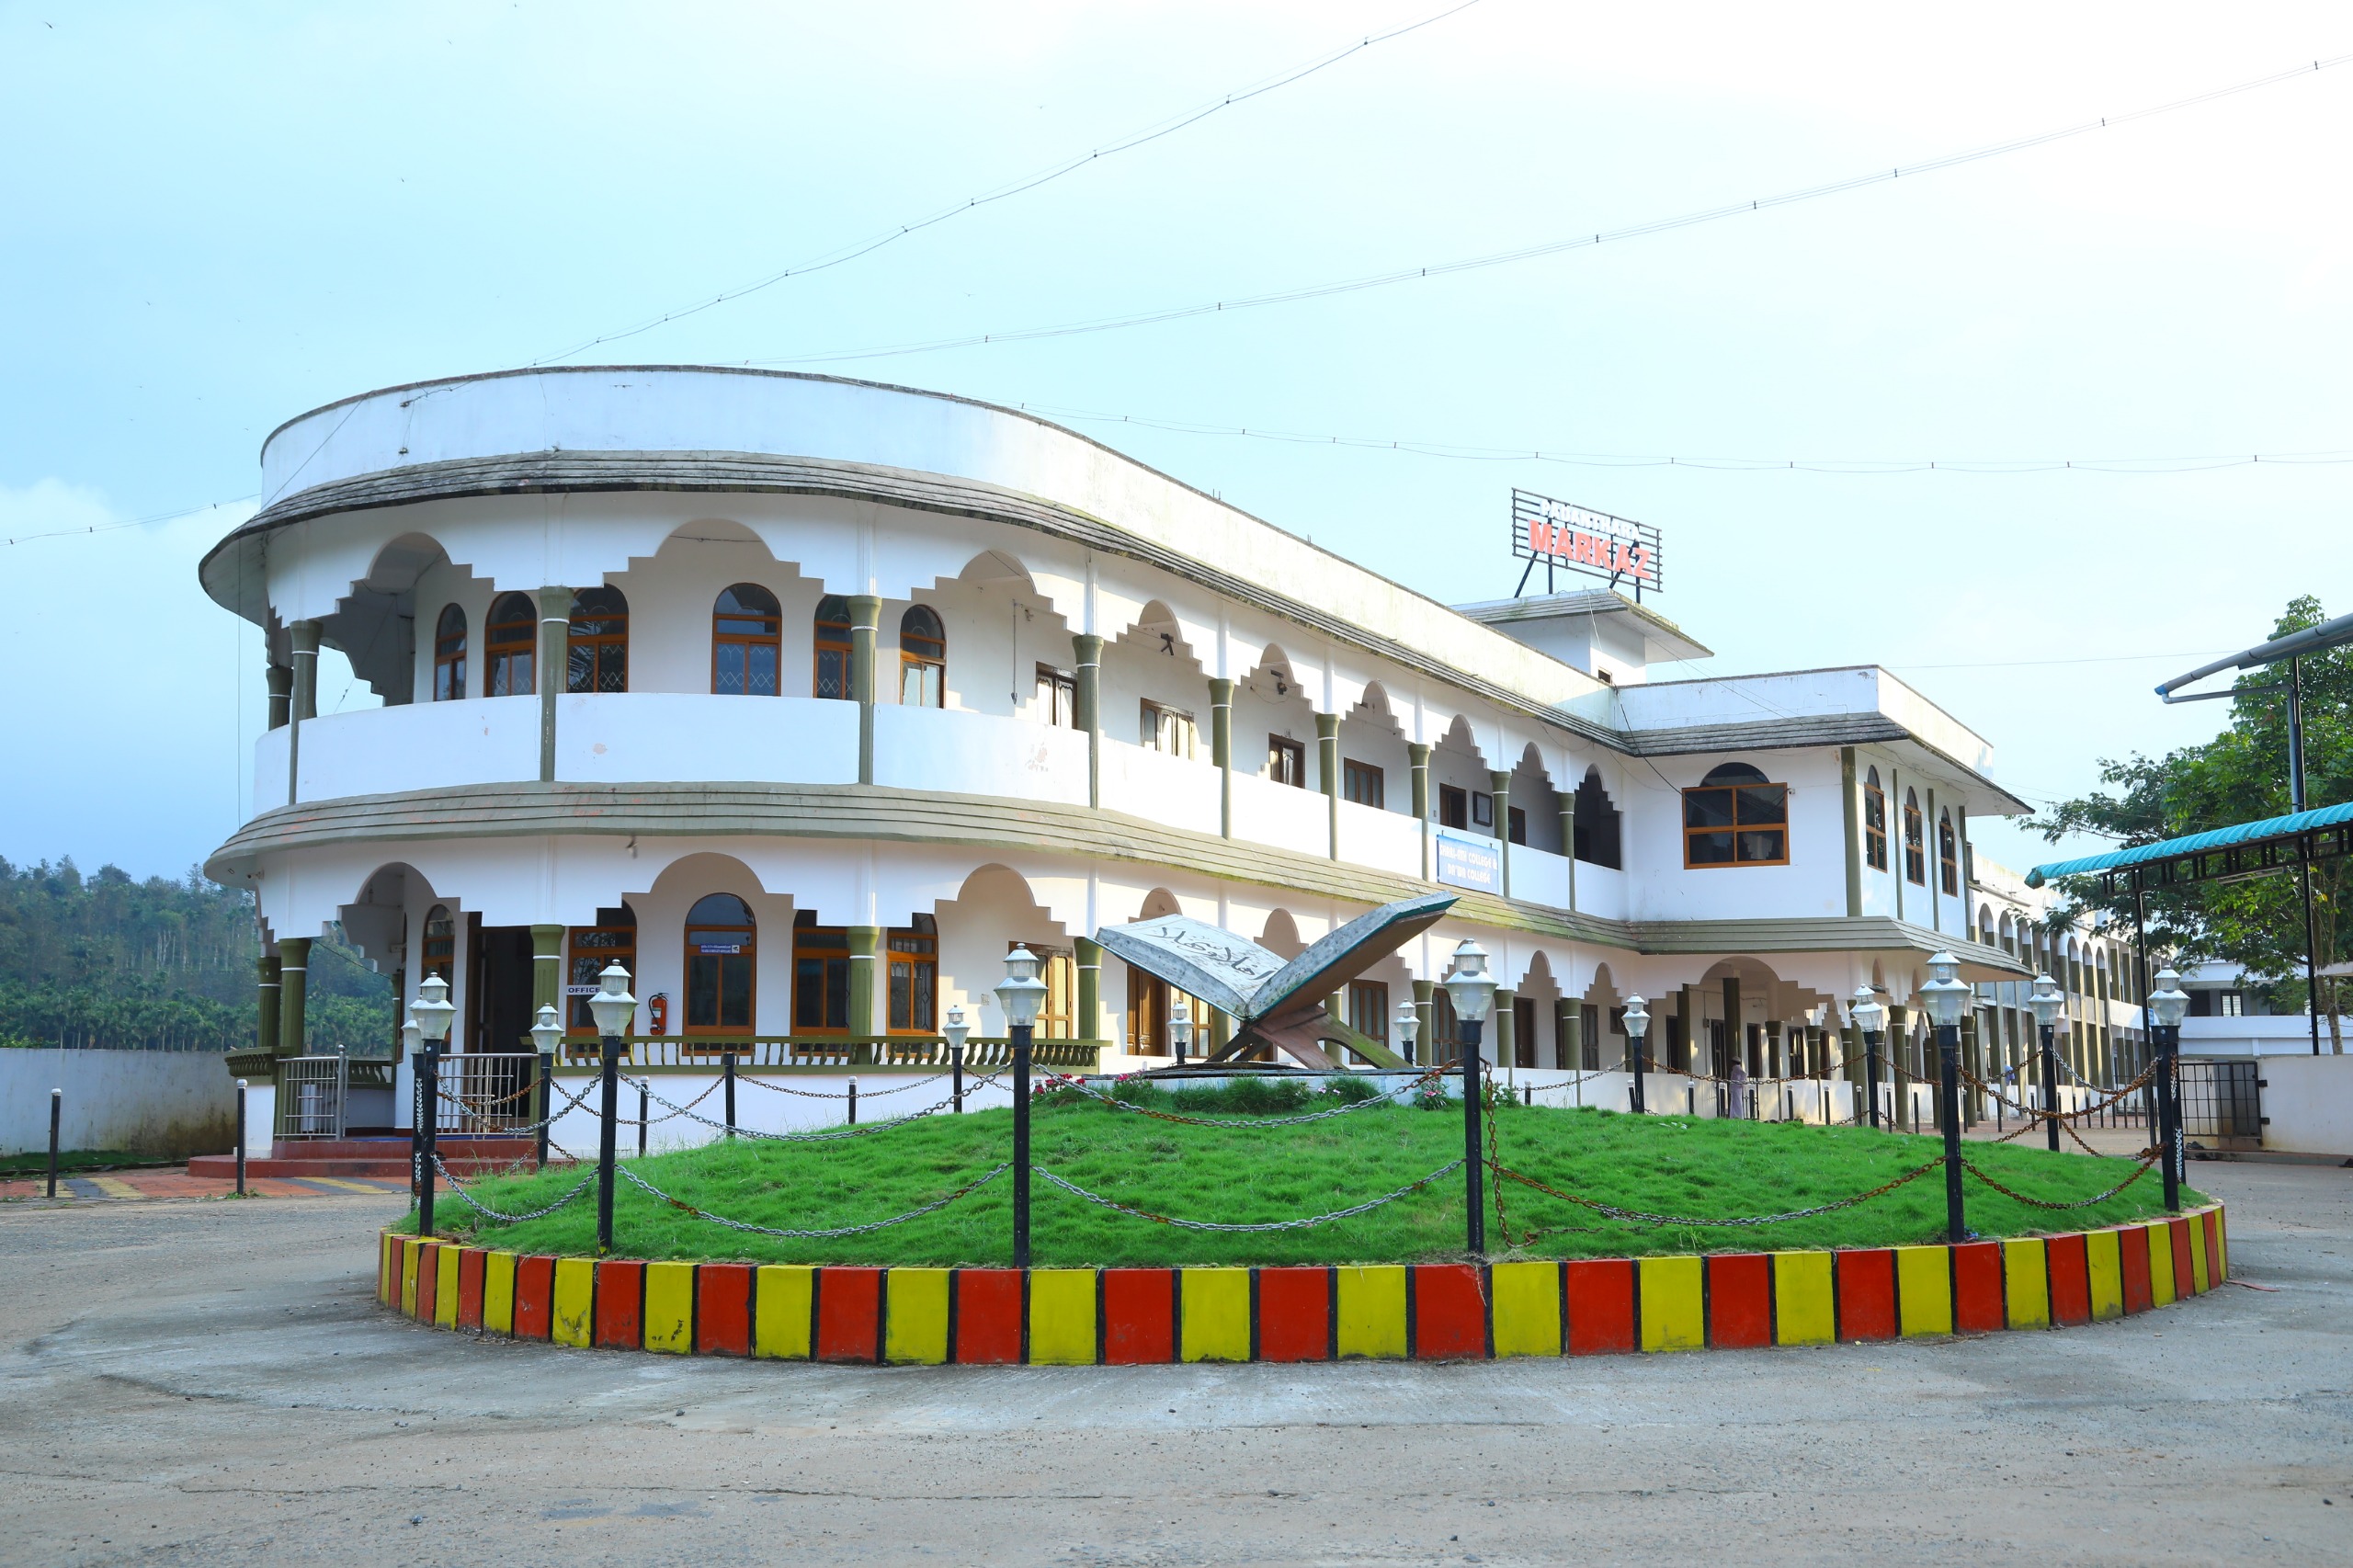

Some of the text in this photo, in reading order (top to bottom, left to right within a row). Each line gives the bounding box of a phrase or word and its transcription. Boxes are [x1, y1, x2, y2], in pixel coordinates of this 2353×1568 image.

[1540, 499, 1640, 541] PADANTHARA
[1528, 519, 1652, 579] MARKAZ
[1468, 852, 1492, 869] COLLEGE
[1467, 869, 1491, 884] COLLEGE
